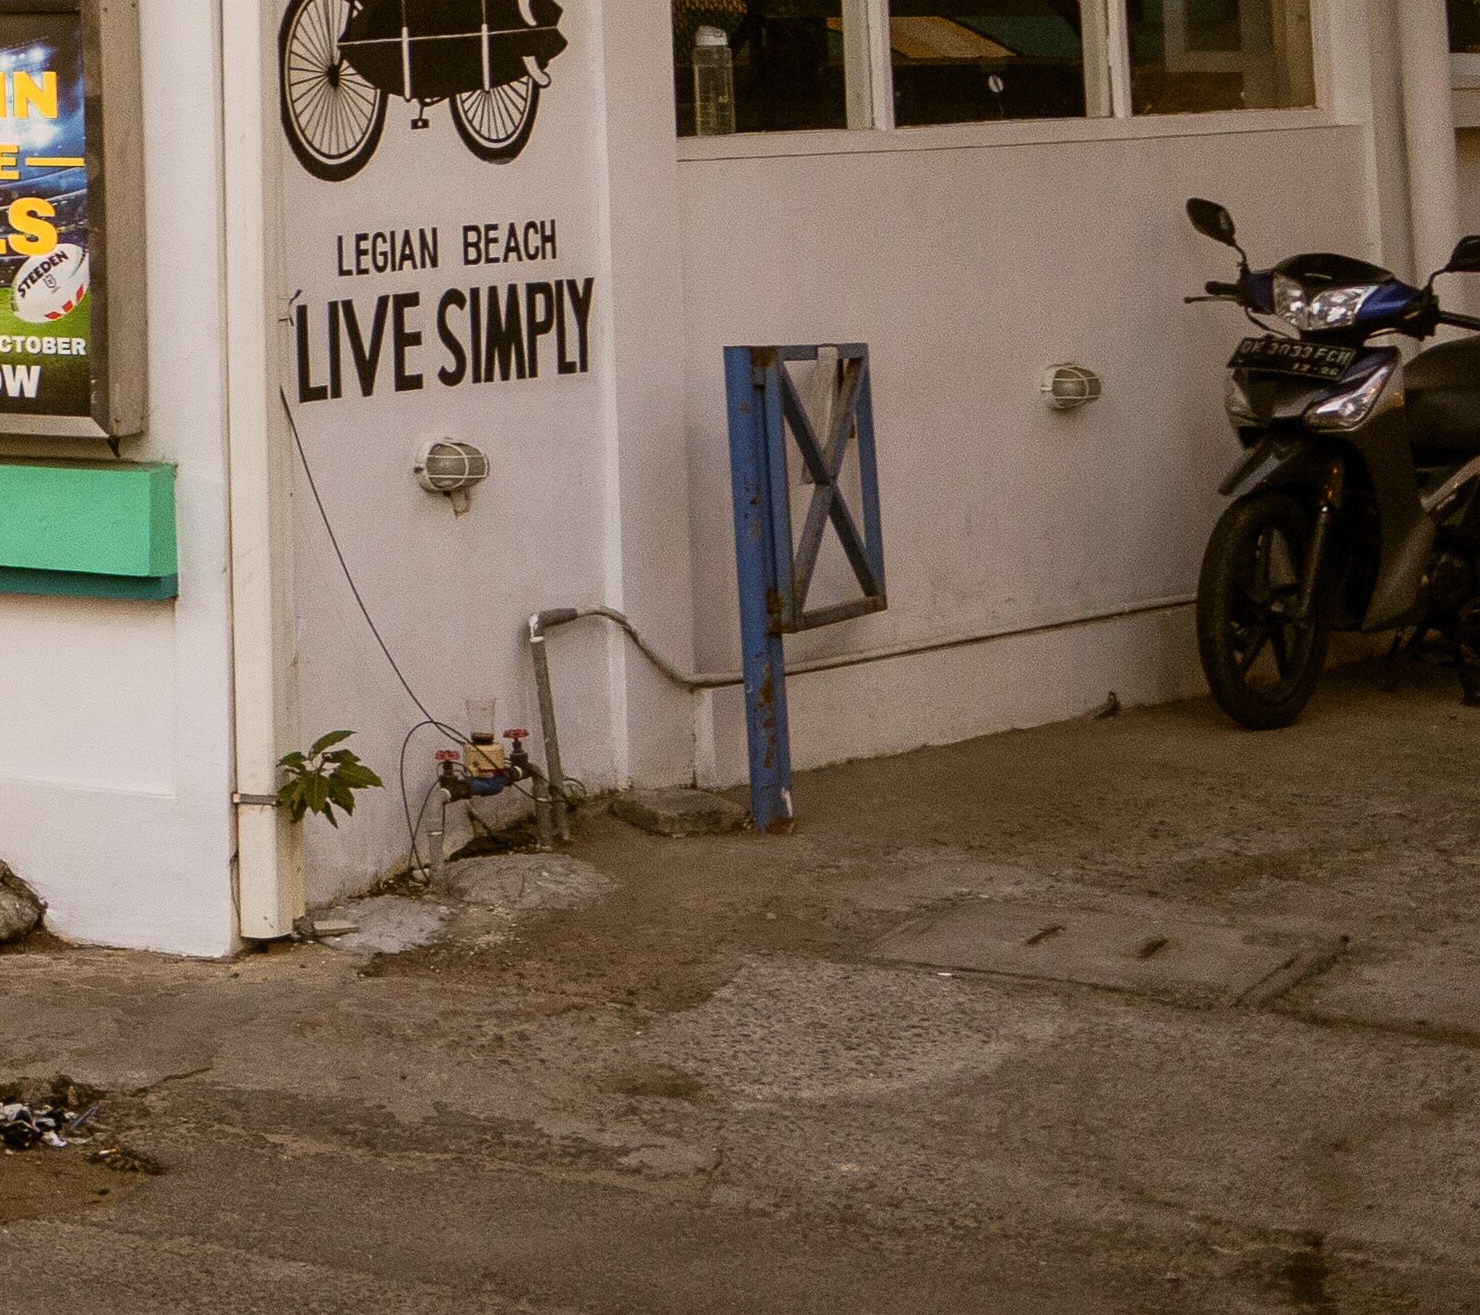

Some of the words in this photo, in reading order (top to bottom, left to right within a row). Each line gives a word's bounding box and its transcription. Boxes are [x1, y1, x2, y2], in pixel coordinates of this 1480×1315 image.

[17, 250, 69, 299] STEEDEN
[337, 225, 440, 279] LEGIAN
[461, 218, 559, 268] BEACH
[296, 289, 426, 406] LIVE
[434, 276, 596, 390] SIMPLY
